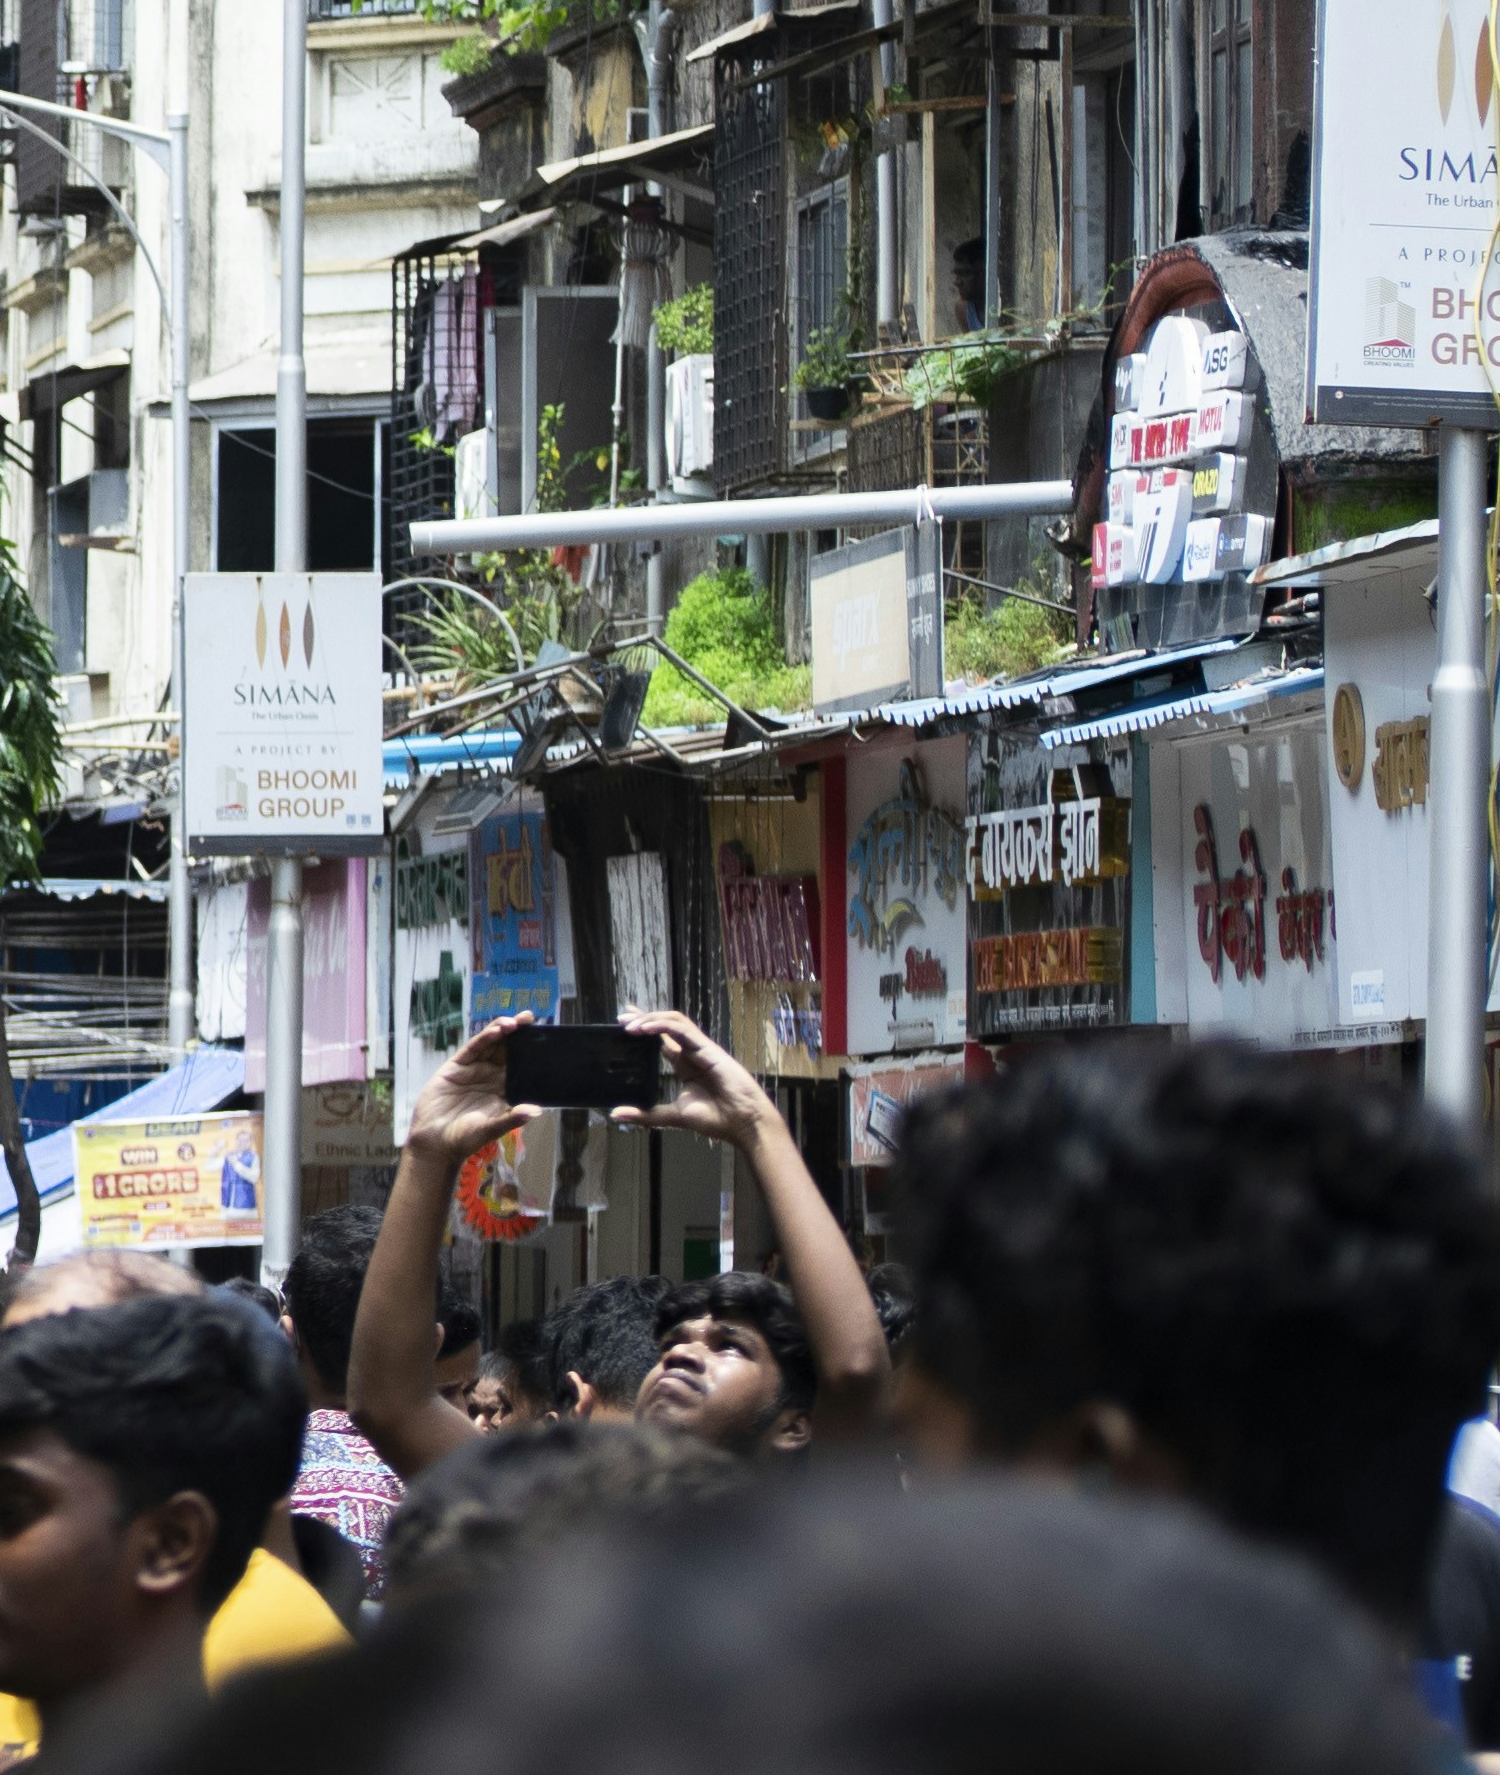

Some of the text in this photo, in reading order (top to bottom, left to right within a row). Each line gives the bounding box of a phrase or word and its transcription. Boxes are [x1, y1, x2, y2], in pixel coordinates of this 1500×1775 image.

[1426, 192, 1493, 209] The Urban
[1398, 247, 1409, 261] A
[1363, 345, 1415, 359] BHOOMI
[251, 712, 266, 721] The
[268, 712, 294, 721] Urban
[235, 745, 338, 756] A PROJECT BY
[257, 770, 357, 790] BHOOMI
[258, 797, 345, 819] GROUP
[122, 1147, 158, 1166] WIN
